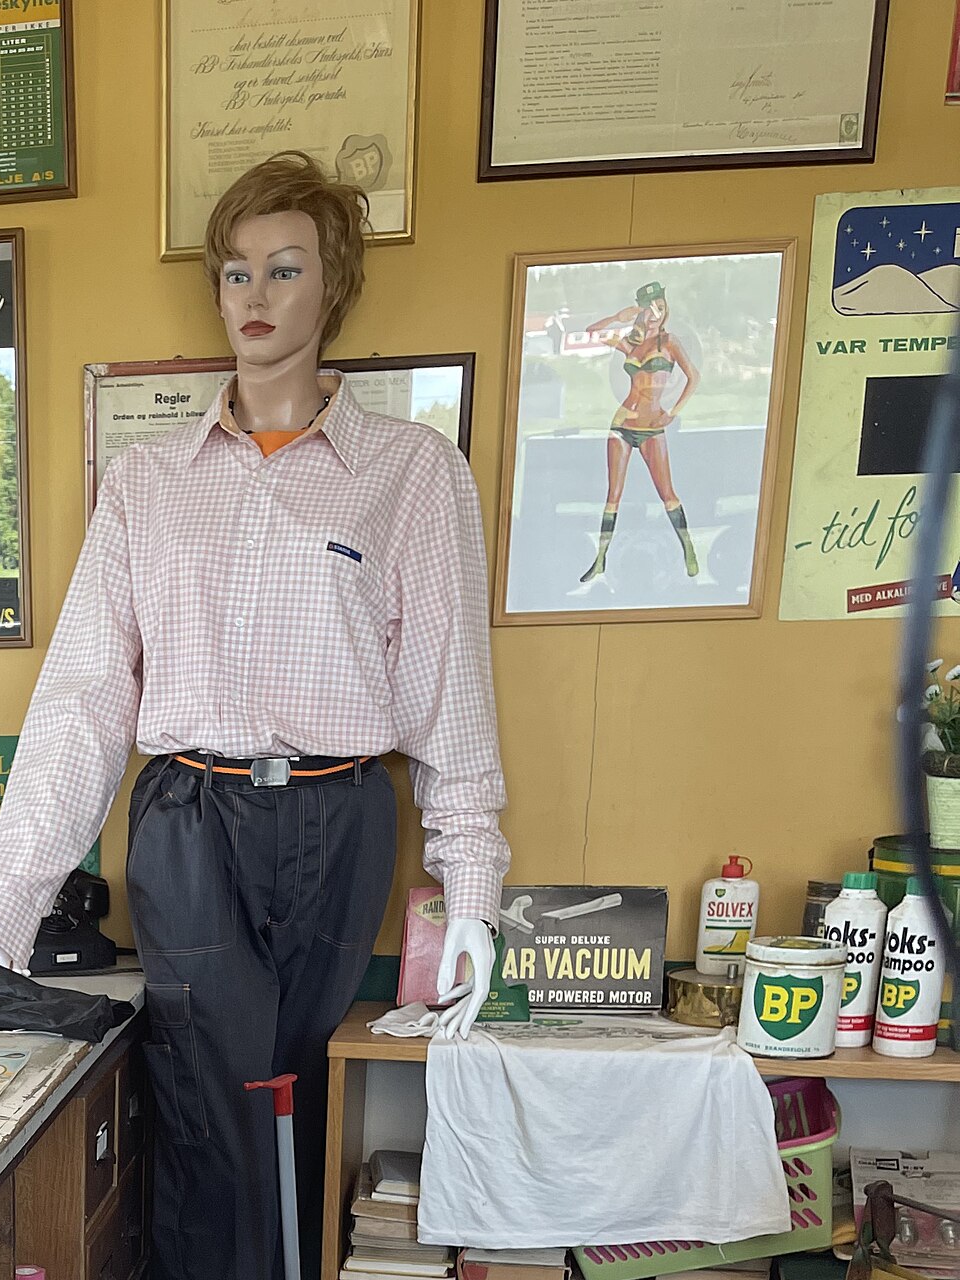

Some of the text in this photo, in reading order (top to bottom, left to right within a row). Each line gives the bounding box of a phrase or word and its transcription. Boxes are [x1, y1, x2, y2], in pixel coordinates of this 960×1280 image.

[25, 21, 51, 30] IKKE
[1, 38, 27, 46] LITER
[815, 338, 867, 356] VAR
[154, 392, 191, 405] Regler
[112, 413, 135, 421] Orden
[137, 413, 146, 421] og
[850, 592, 872, 605] MED
[707, 901, 754, 918] SOLVEX
[534, 935, 611, 945] SUPER DELUXE
[884, 926, 936, 955] oks-
[543, 947, 652, 980] VACUUM
[548, 989, 605, 1004] POWERED
[609, 990, 652, 1004] MOTOR
[881, 982, 916, 1009] BP
[759, 984, 818, 1024] BP
